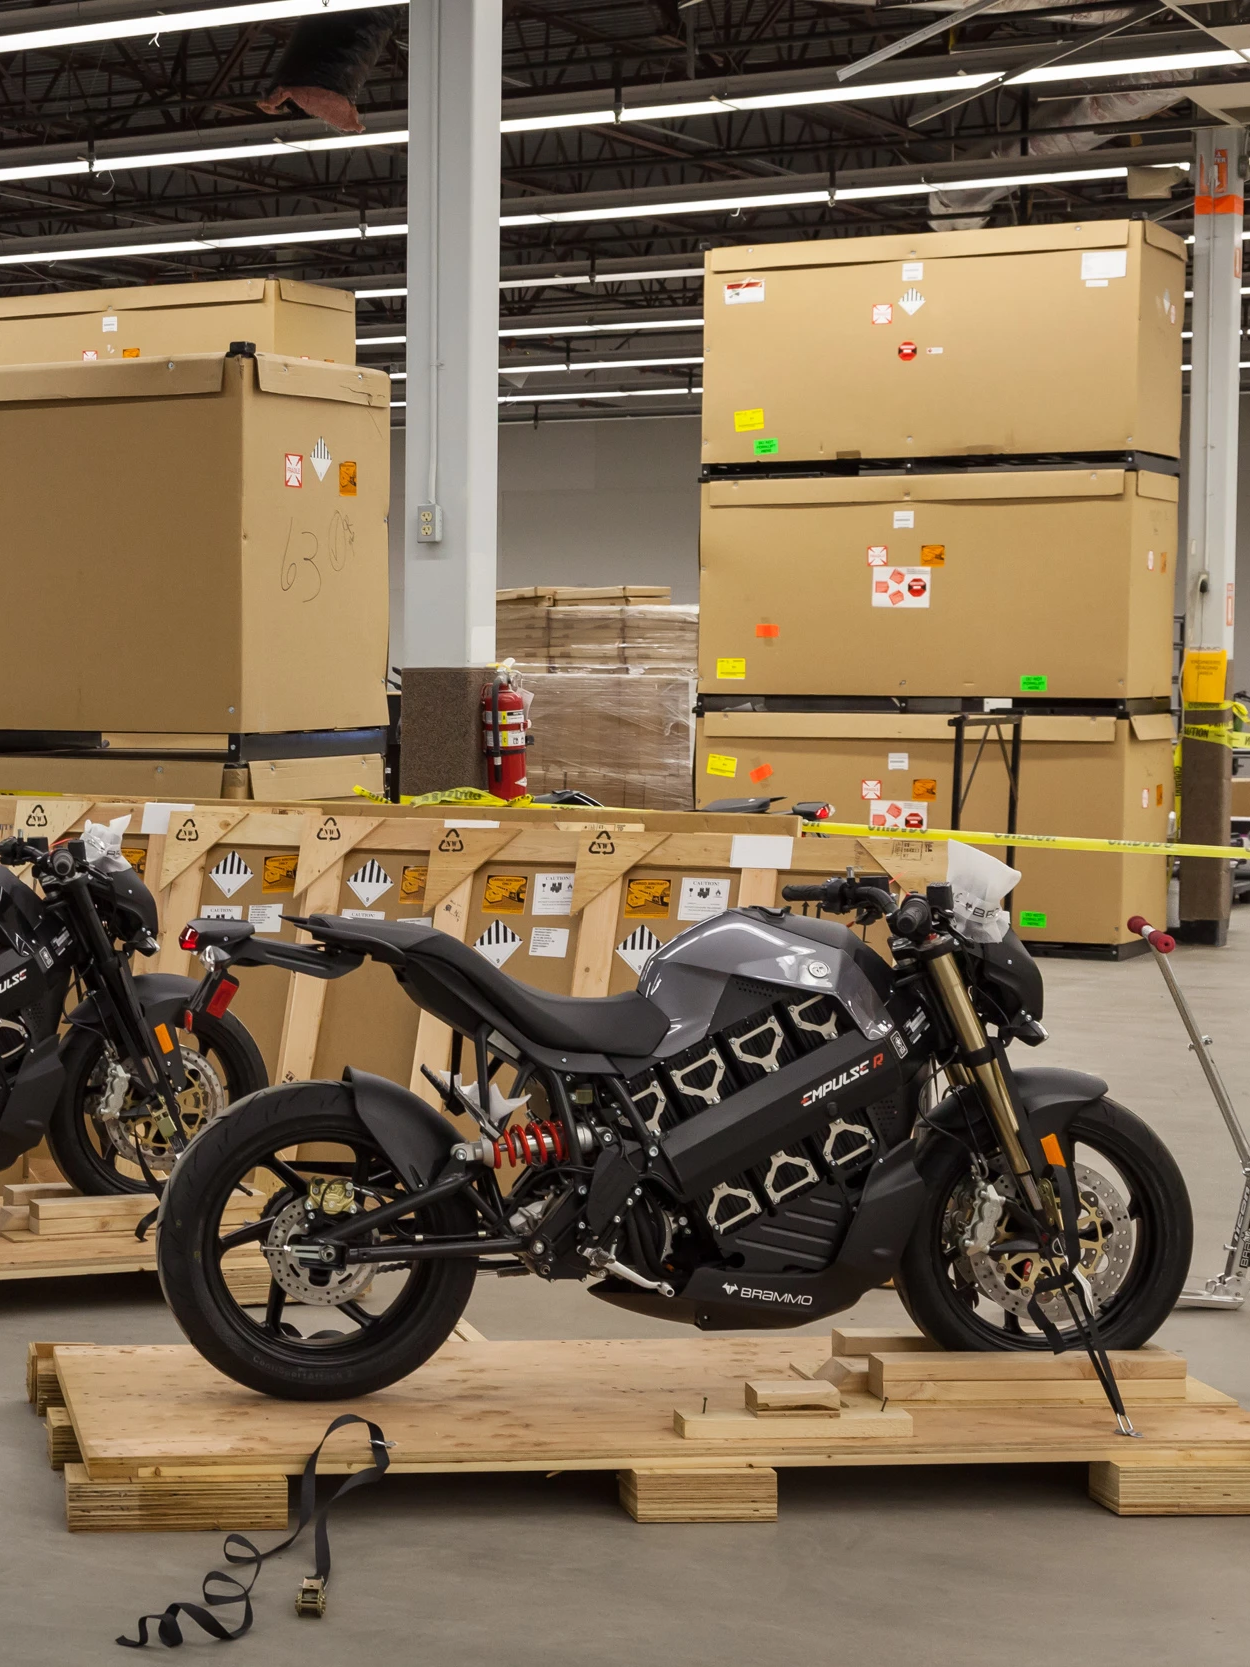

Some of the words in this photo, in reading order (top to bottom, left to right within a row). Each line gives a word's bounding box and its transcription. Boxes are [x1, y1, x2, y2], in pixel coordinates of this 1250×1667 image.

[1184, 726, 1210, 739] AUTION
[800, 1059, 869, 1107] EMPULSE
[873, 1053, 884, 1069] R
